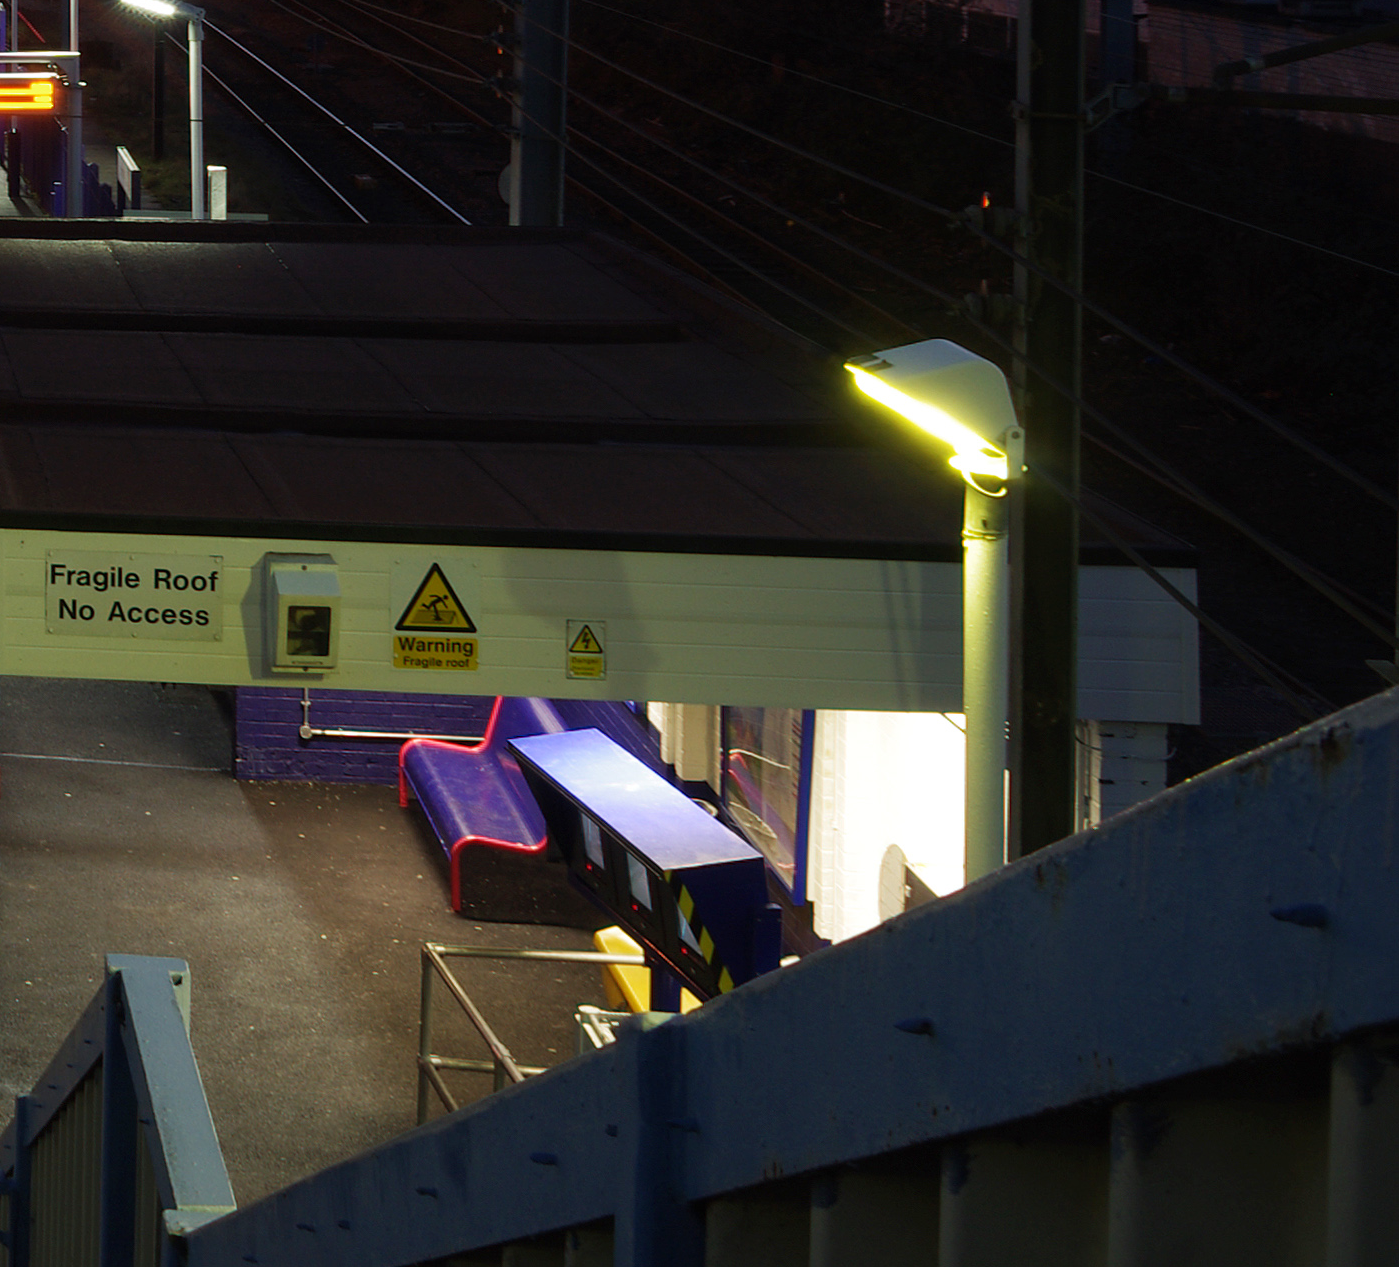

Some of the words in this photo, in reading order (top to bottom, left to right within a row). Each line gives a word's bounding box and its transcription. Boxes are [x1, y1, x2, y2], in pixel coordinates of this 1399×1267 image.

[50, 563, 140, 592] Fragile
[153, 568, 219, 592] Roof
[58, 598, 96, 621] No
[107, 601, 210, 626] Access
[397, 636, 474, 657] Warning
[403, 655, 443, 668] Fragile
[446, 658, 470, 668] roof
